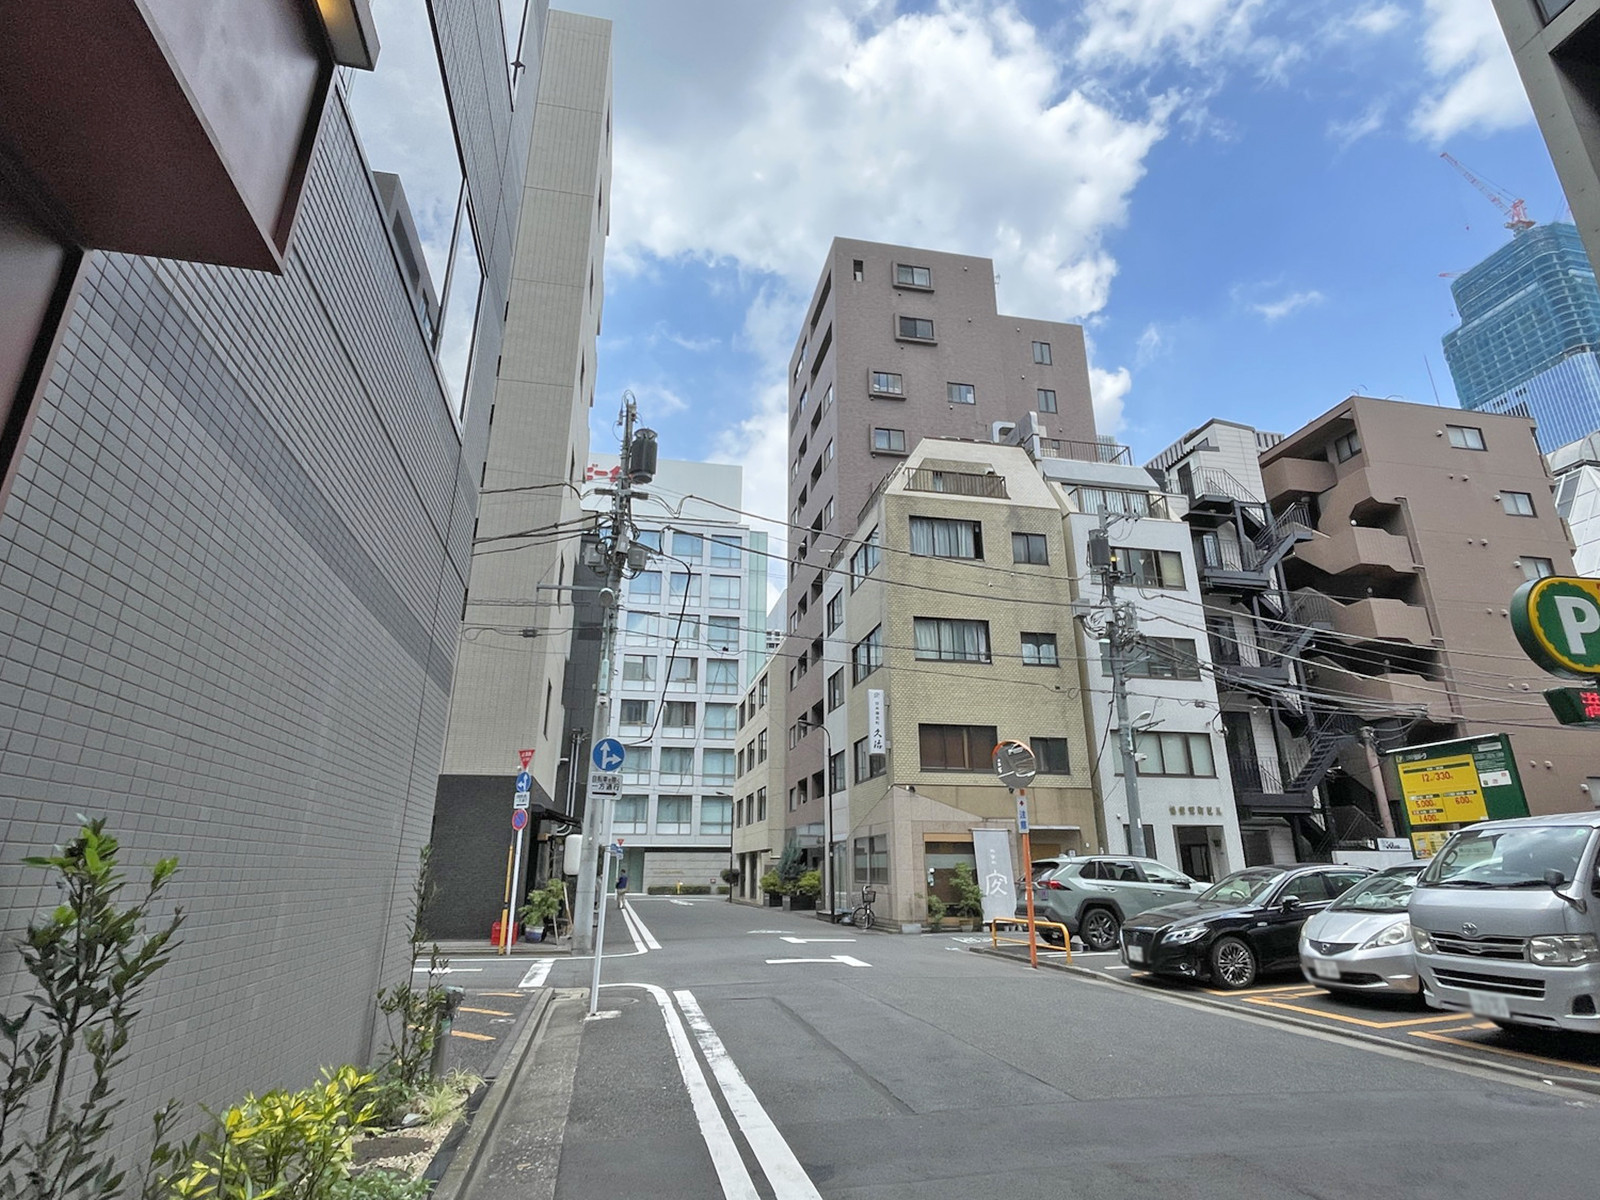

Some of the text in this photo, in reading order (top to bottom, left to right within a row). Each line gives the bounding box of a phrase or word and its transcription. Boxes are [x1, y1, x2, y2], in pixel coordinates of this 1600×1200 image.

[1553, 595, 1600, 655] P
[592, 783, 620, 791] 一方通行
